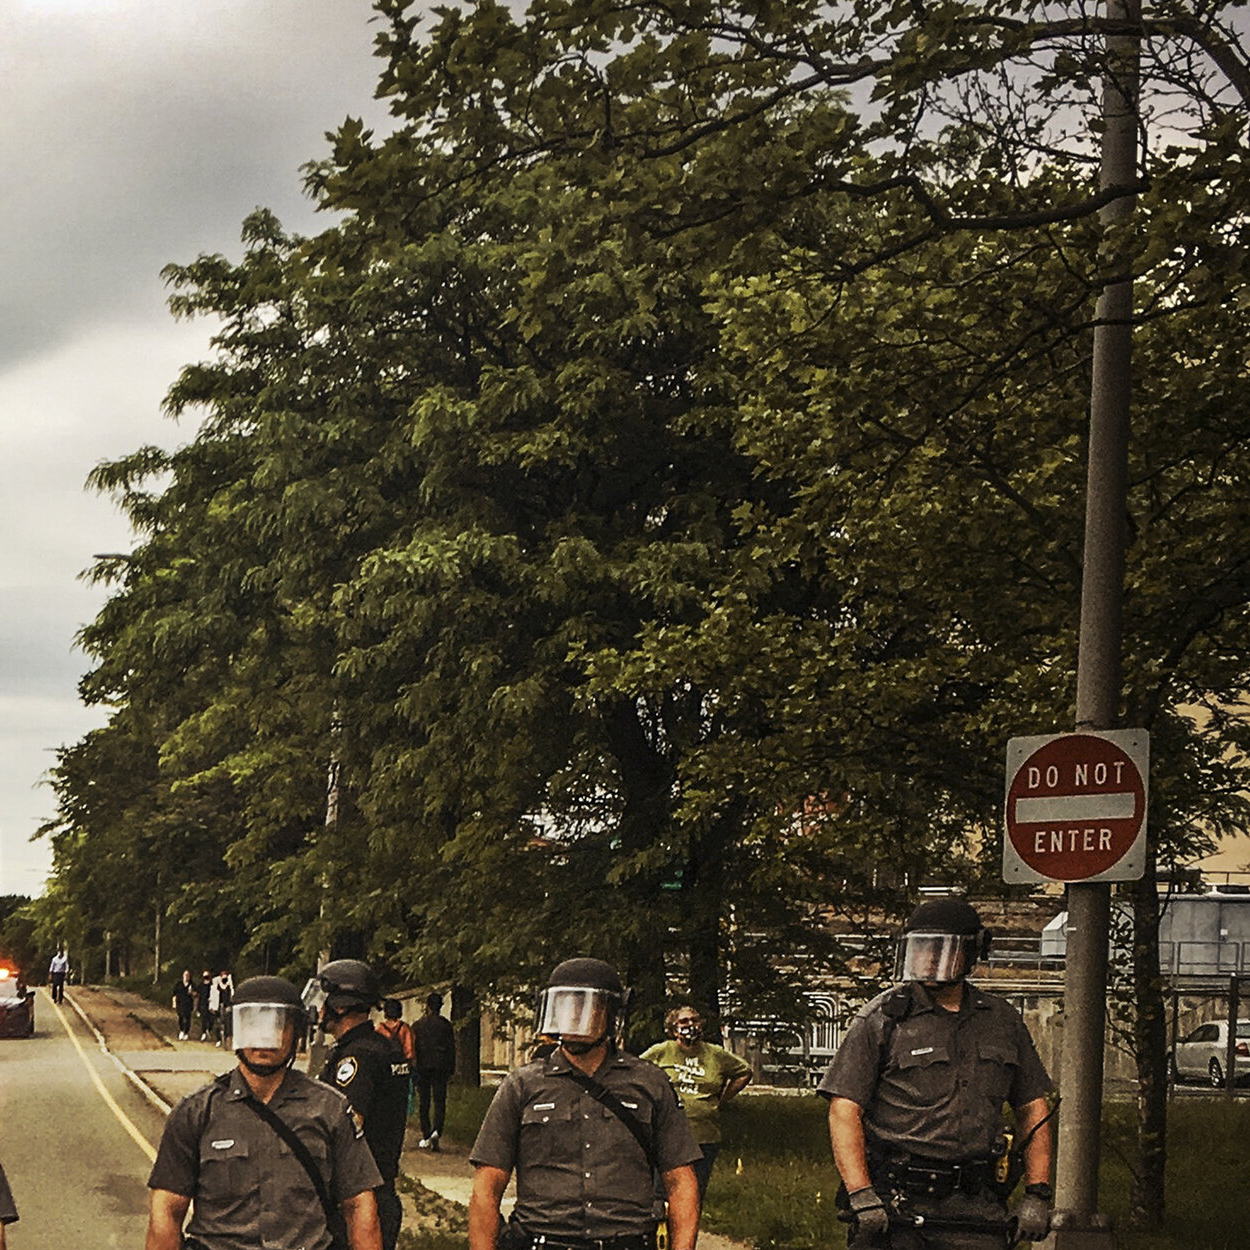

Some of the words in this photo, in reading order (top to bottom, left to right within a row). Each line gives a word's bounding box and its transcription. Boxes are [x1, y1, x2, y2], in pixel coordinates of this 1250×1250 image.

[1028, 765, 1059, 789] DO
[1075, 761, 1125, 786] NOT
[1034, 828, 1112, 853] ENTER
